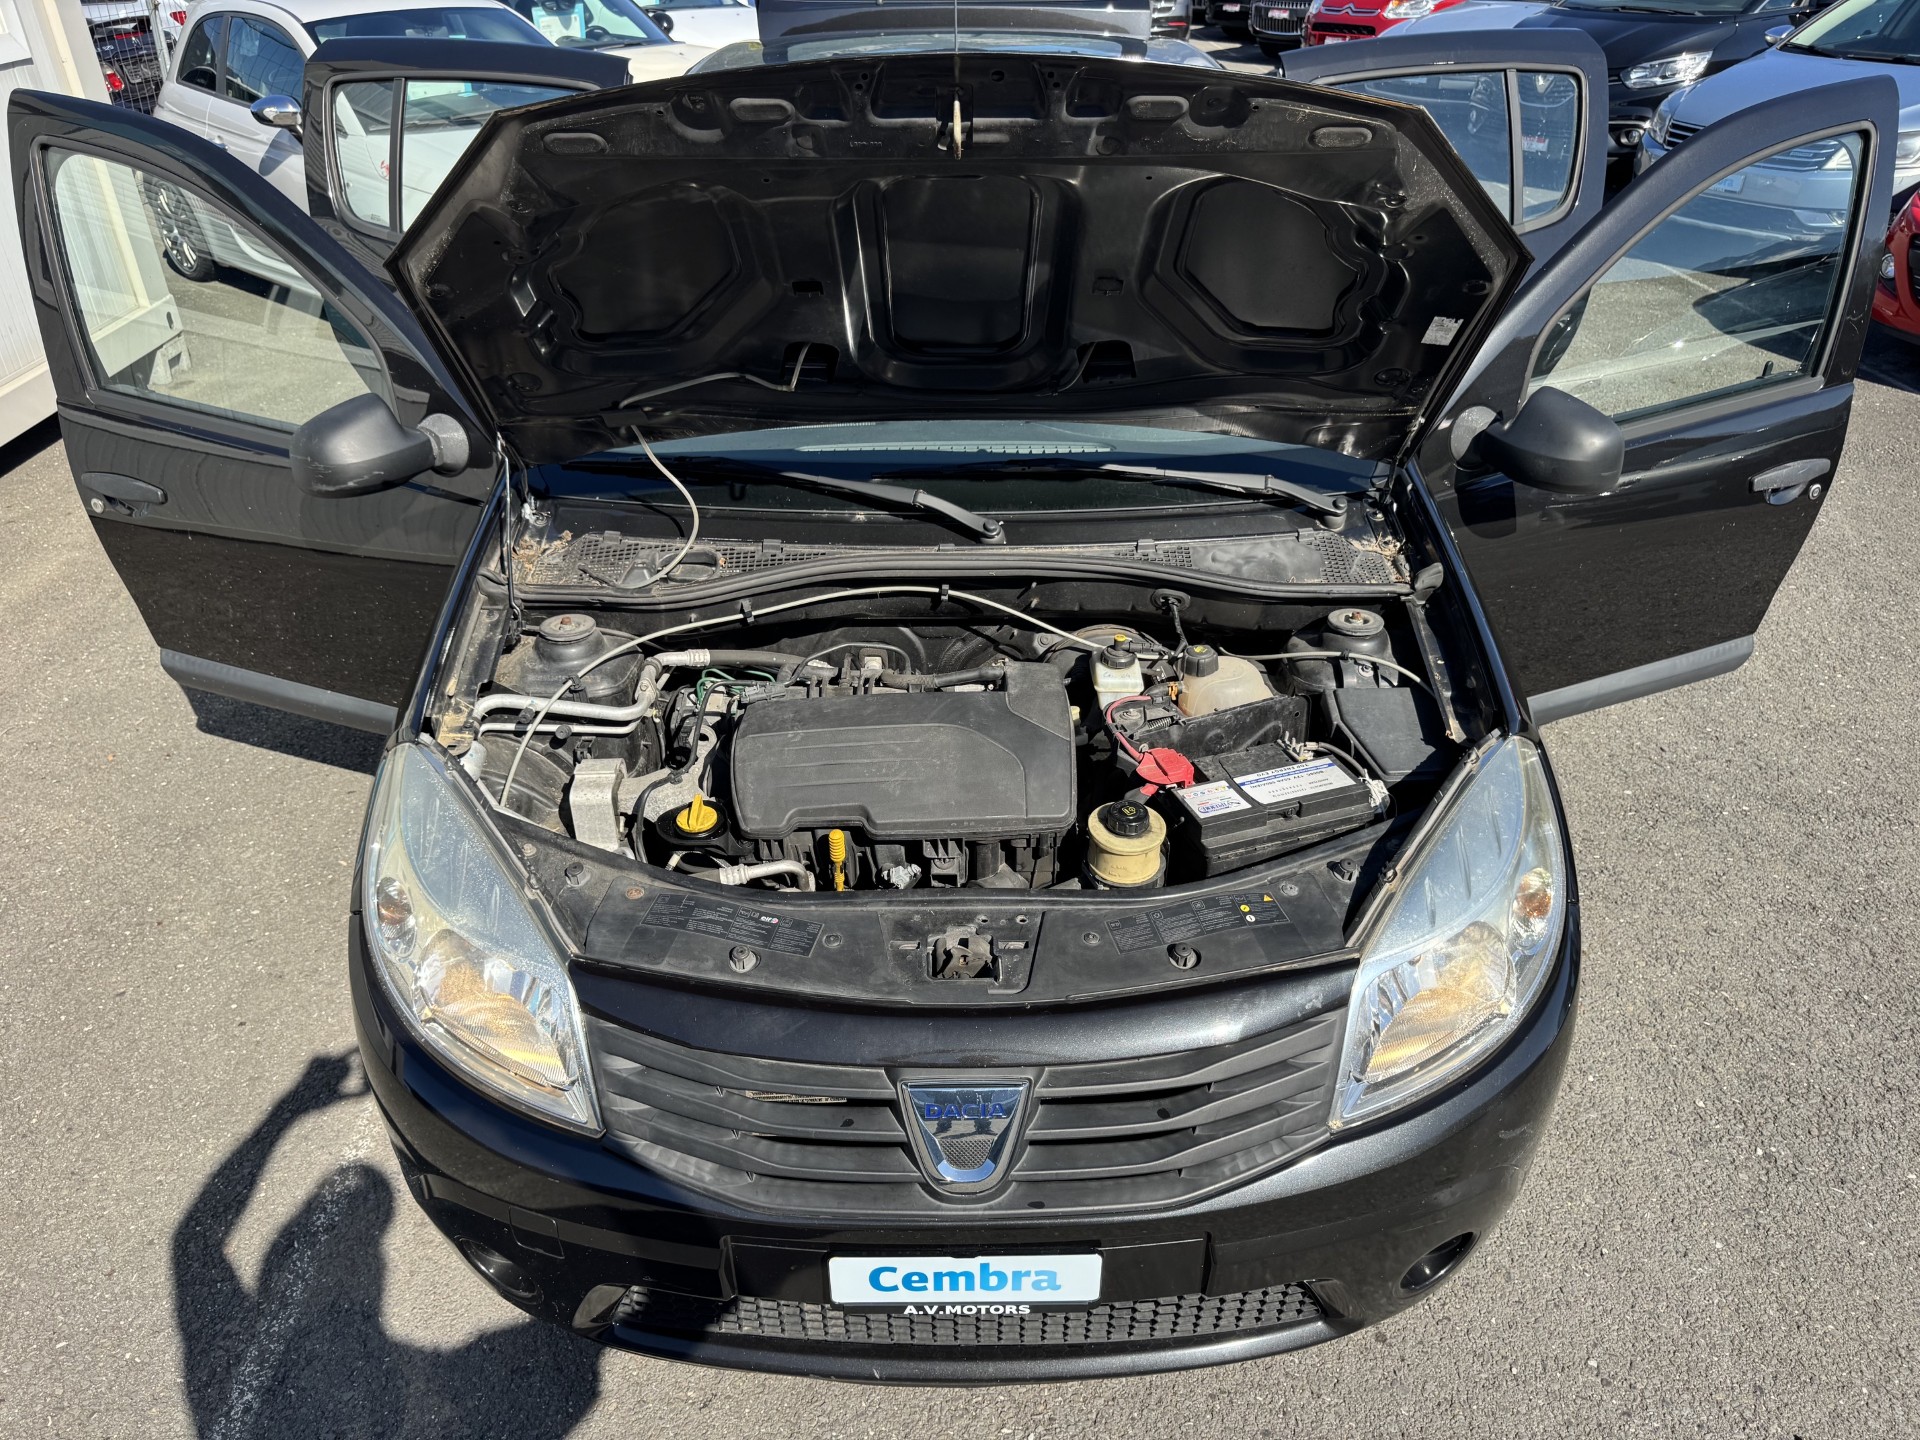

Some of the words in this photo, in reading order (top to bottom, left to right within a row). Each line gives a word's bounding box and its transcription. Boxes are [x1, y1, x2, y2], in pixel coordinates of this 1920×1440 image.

[924, 1103, 1007, 1119] DACIA
[868, 1262, 1062, 1292] Cembra
[903, 1304, 1031, 1315] A.V.MOTORS
